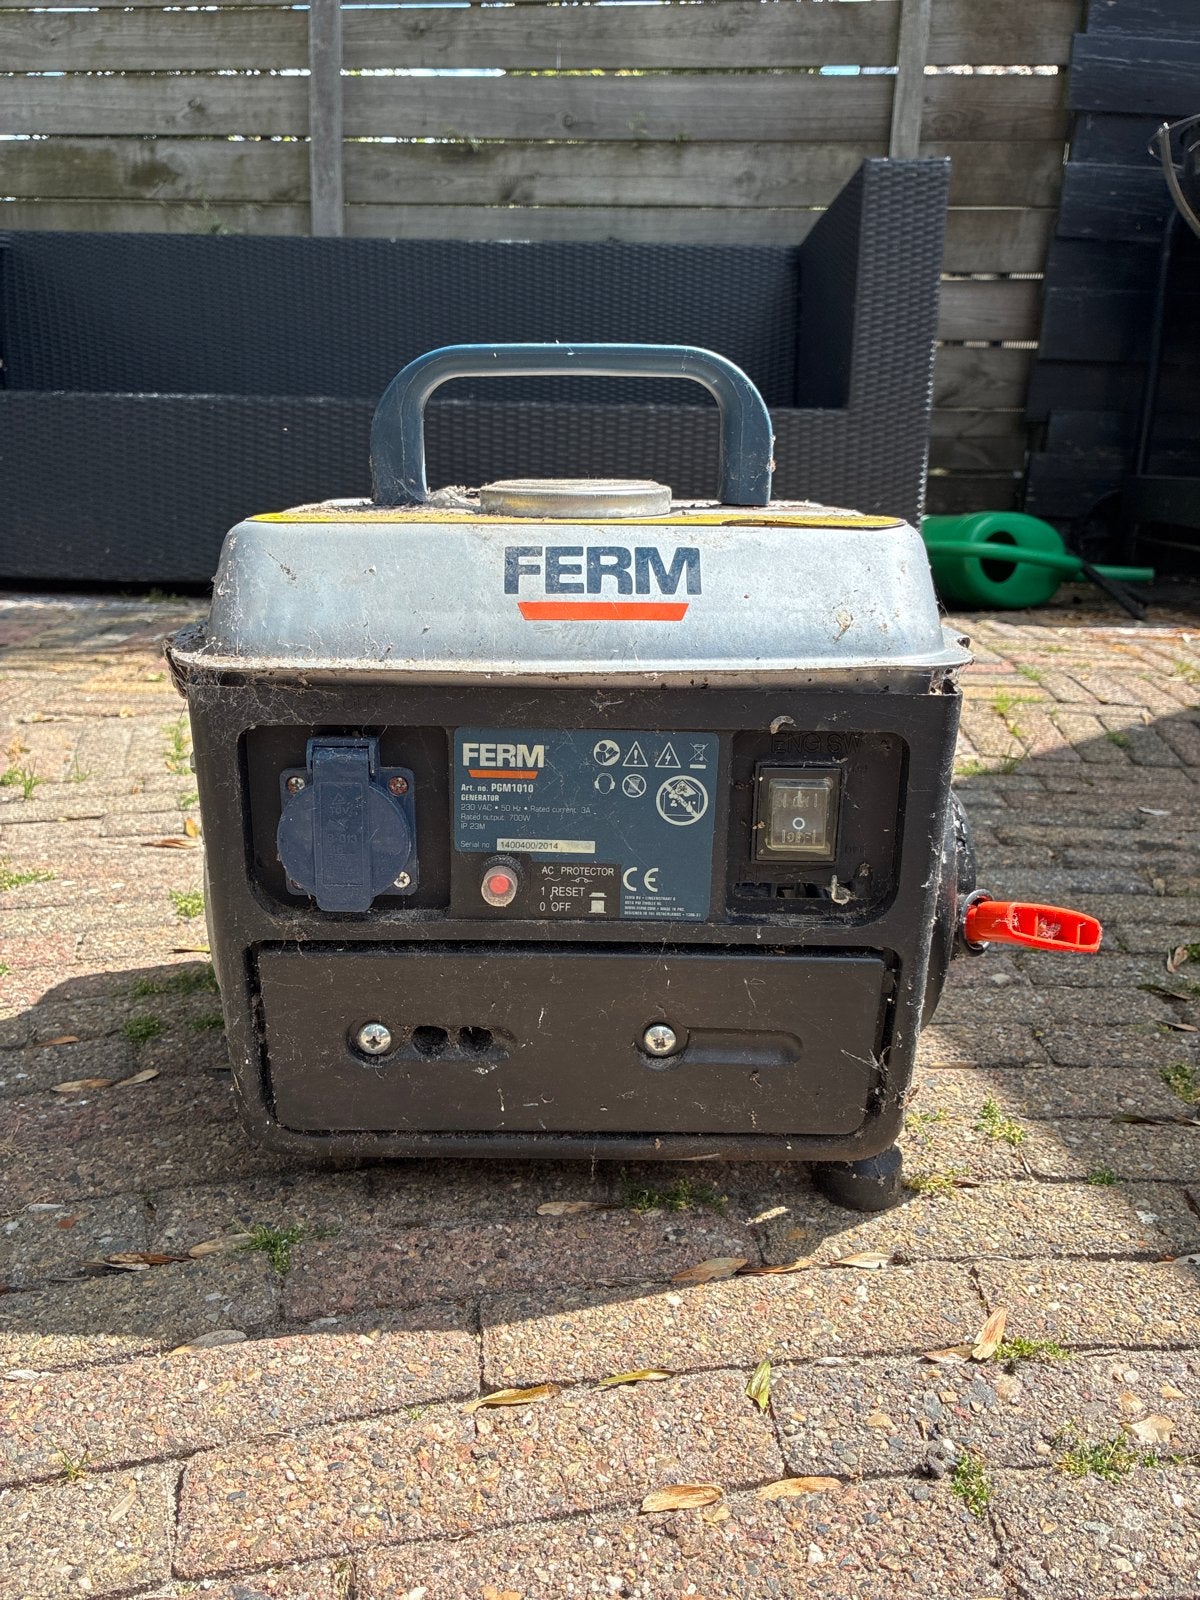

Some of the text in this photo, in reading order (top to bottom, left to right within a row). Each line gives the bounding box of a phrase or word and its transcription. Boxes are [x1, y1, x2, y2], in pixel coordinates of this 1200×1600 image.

[504, 546, 702, 595] FERM
[462, 742, 545, 768] FERM
[460, 783, 475, 792] Art.
[491, 783, 534, 793] PGM1010
[460, 793, 500, 802] GENERATOR
[460, 803, 476, 811] 230
[477, 803, 493, 811] VAC
[500, 804, 511, 812] 50
[512, 804, 522, 812] Hz
[530, 805, 550, 813] Rated
[580, 806, 591, 814] 3A
[460, 812, 481, 821] Rated
[509, 813, 531, 822] 700W
[460, 822, 486, 830] IP 23M
[460, 840, 480, 849] Serial
[500, 840, 559, 850] 1400400/2014
[541, 866, 615, 877] AC PROTECTOR
[622, 866, 660, 893] CE
[551, 886, 586, 897] RESET
[550, 902, 572, 912] OFF
